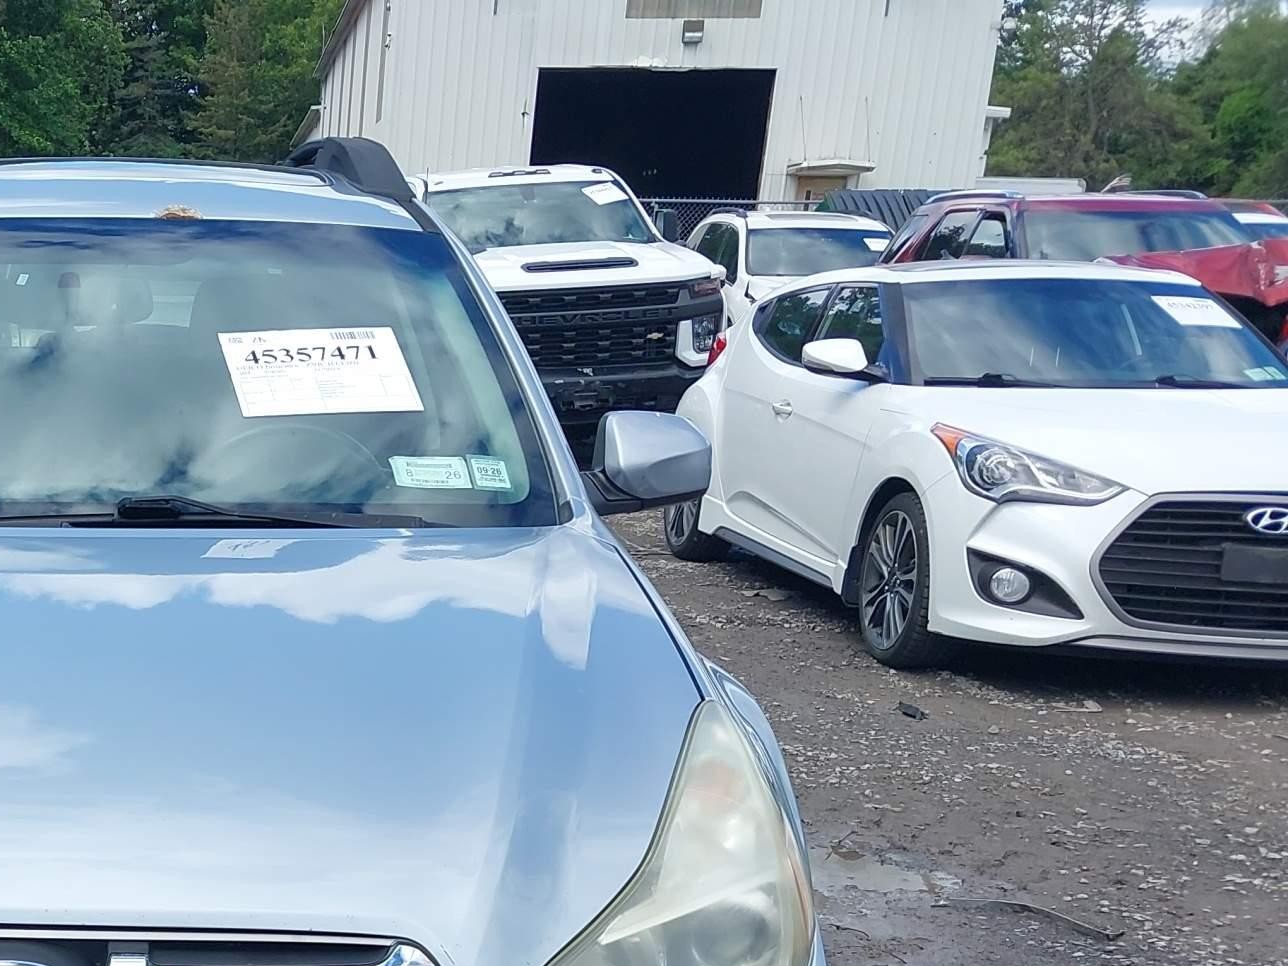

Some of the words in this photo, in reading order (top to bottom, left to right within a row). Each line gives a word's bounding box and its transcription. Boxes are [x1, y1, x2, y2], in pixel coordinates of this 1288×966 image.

[512, 308, 679, 328] HEVROLET
[245, 345, 379, 364] 45357471
[445, 471, 462, 479] 26
